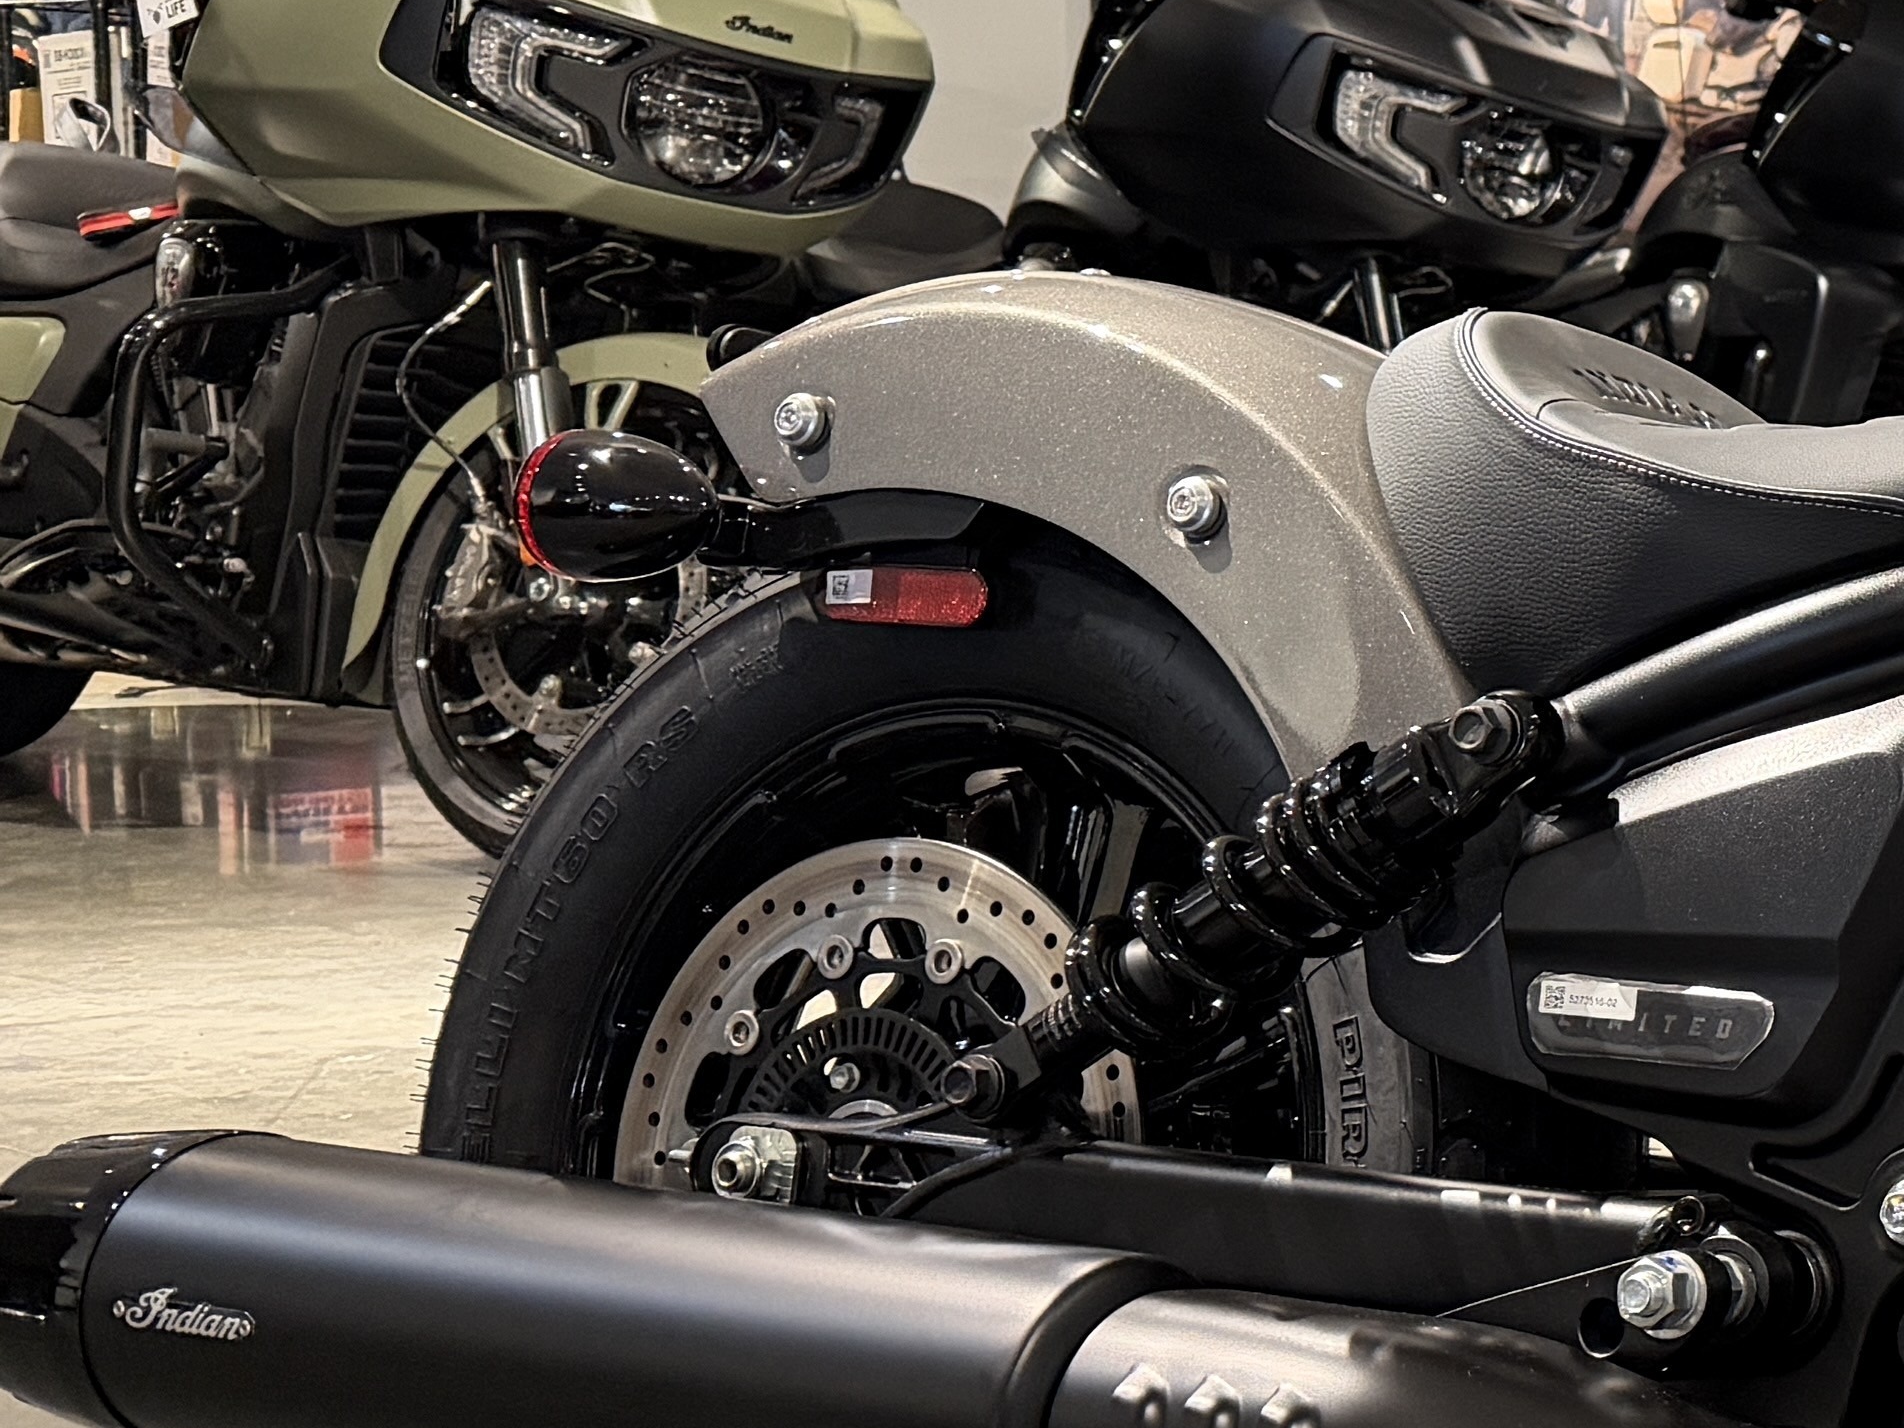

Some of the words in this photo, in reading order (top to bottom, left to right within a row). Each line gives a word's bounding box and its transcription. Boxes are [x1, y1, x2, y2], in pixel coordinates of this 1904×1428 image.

[725, 15, 793, 44] Indian
[1332, 1014, 1369, 1167] PIR
[125, 1287, 241, 1341] Indian
